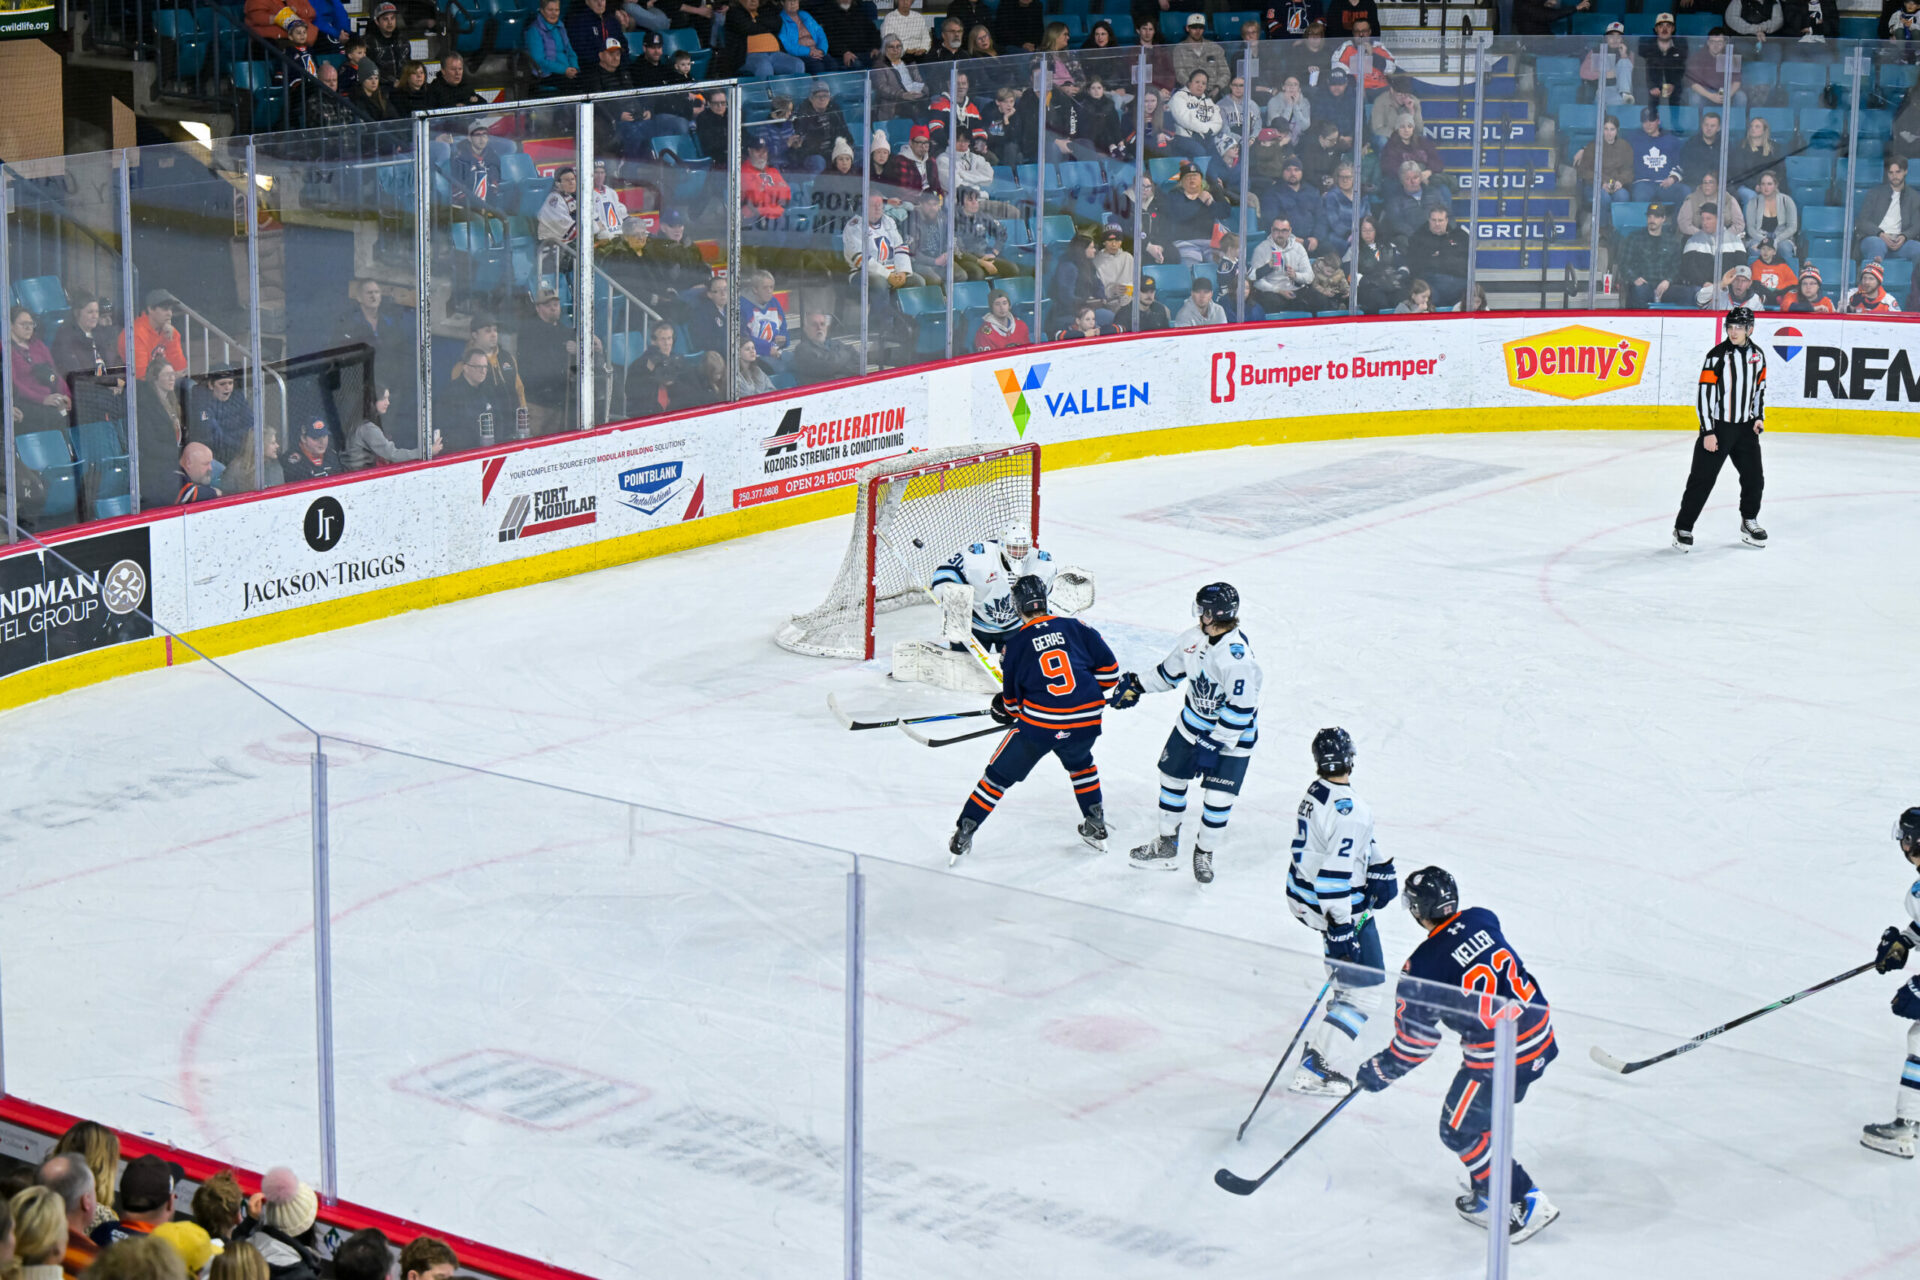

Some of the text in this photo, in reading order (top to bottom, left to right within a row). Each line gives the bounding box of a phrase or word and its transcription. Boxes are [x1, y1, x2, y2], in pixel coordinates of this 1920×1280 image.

[1241, 357, 1437, 387] Bumper to Bumper
[1513, 341, 1638, 380] Denny's
[1044, 382, 1149, 418] VALLEN
[510, 439, 685, 479] YOUR COMPLETE SOURCE FOR MODULAR BUILDING SOLUTIONS
[764, 433, 904, 474] KOZORIS STRENGTH & CONDITIONING
[624, 465, 677, 488] POINTBLANK
[785, 477, 812, 493] OPEN
[814, 475, 825, 487] 24
[534, 486, 568, 506] FORT
[534, 495, 596, 522] MODULAR
[29, 599, 98, 633] GROUP
[1032, 632, 1065, 653] GERAS
[1039, 649, 1076, 696] 9
[1233, 679, 1245, 695] 8
[1338, 838, 1353, 857] 2
[1451, 930, 1495, 968] KELLER
[1461, 947, 1536, 1030] 22
